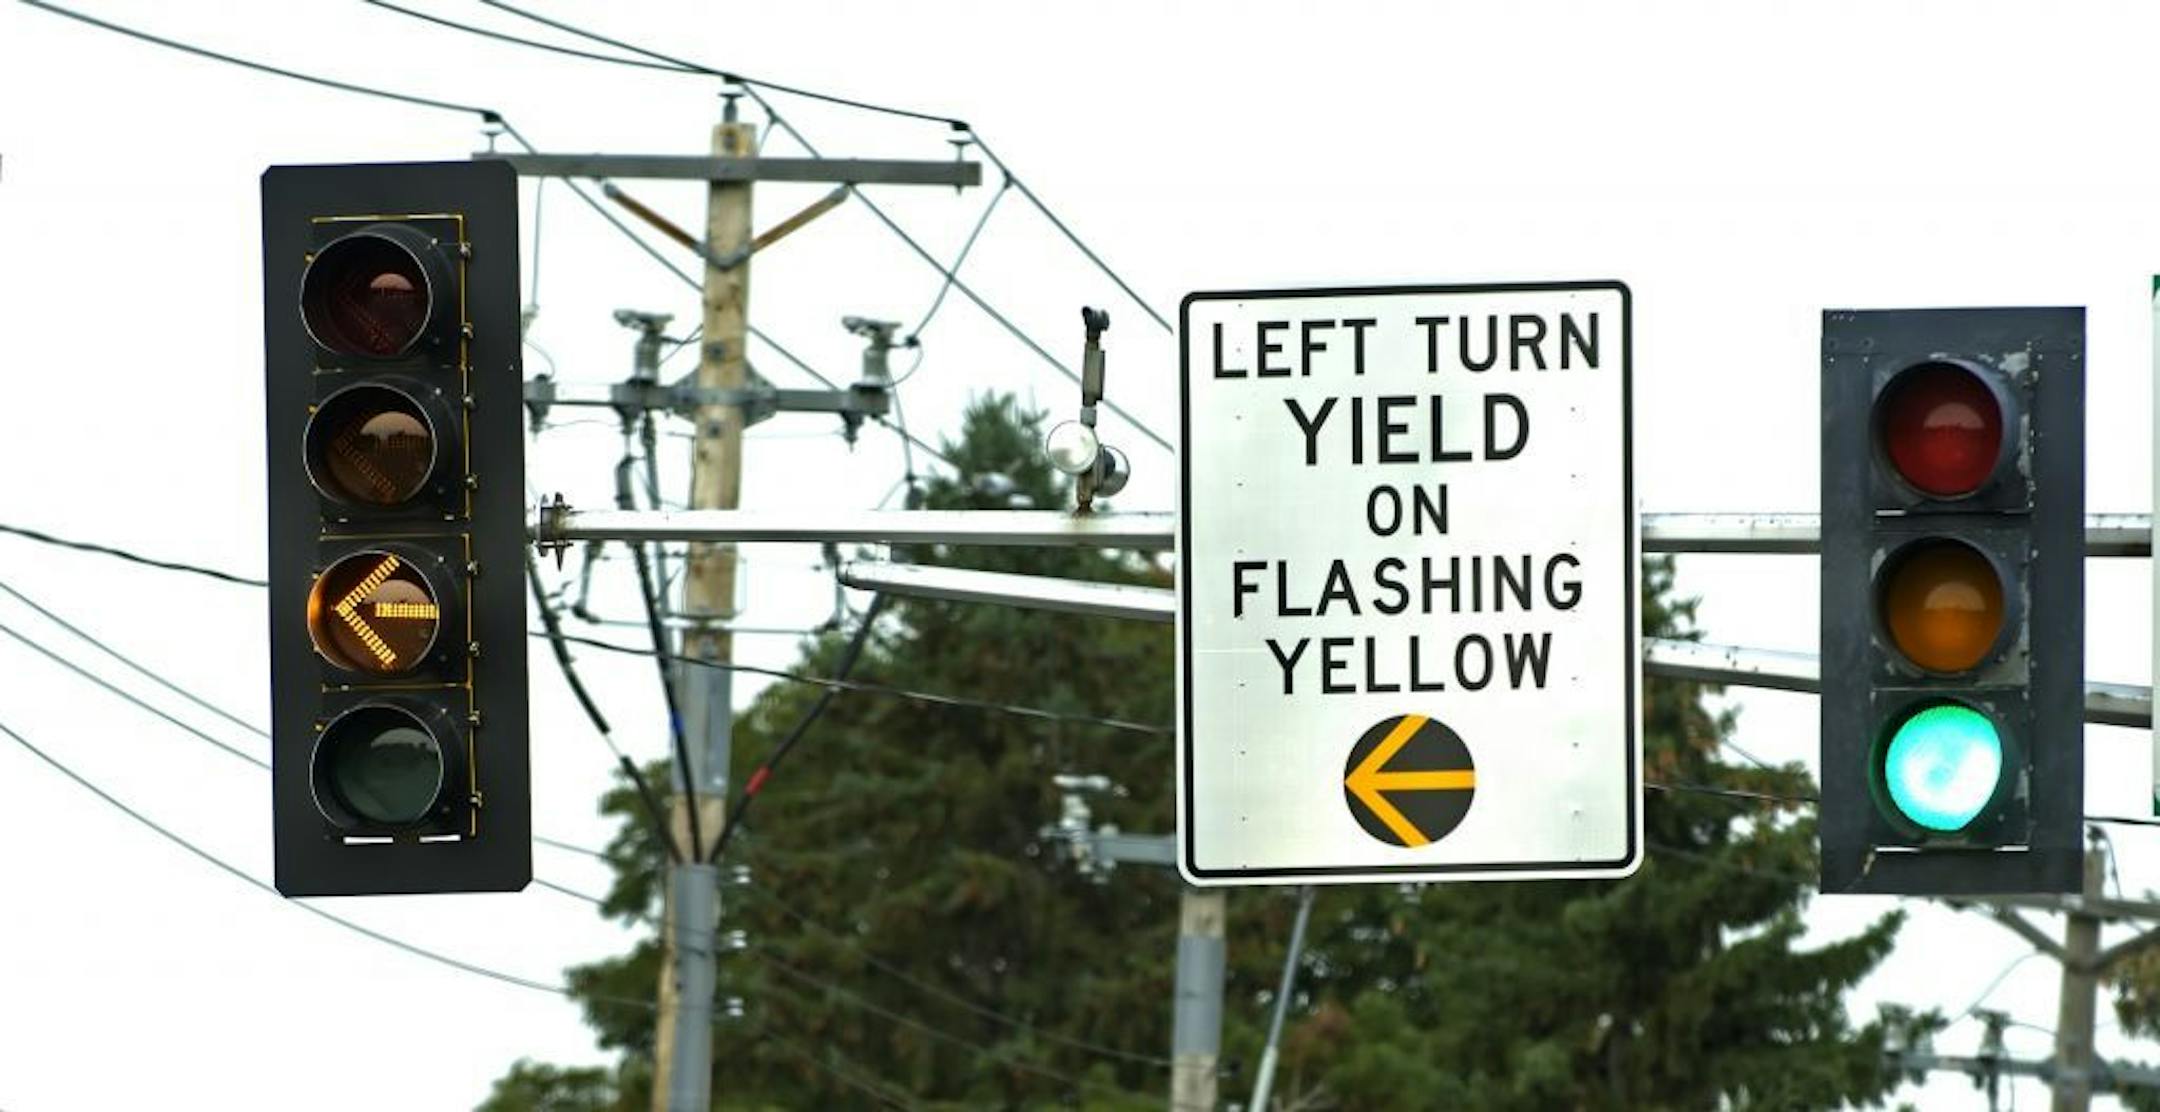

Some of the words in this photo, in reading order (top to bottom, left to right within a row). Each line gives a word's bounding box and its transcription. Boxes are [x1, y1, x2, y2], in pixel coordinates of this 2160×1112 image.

[1213, 318, 1377, 379] LEFT
[1415, 312, 1599, 373] TURN
[1283, 393, 1529, 466] YIELD
[1366, 483, 1448, 537] ON
[1233, 553, 1583, 618] FLASHING
[1265, 632, 1552, 695] YELLOW
